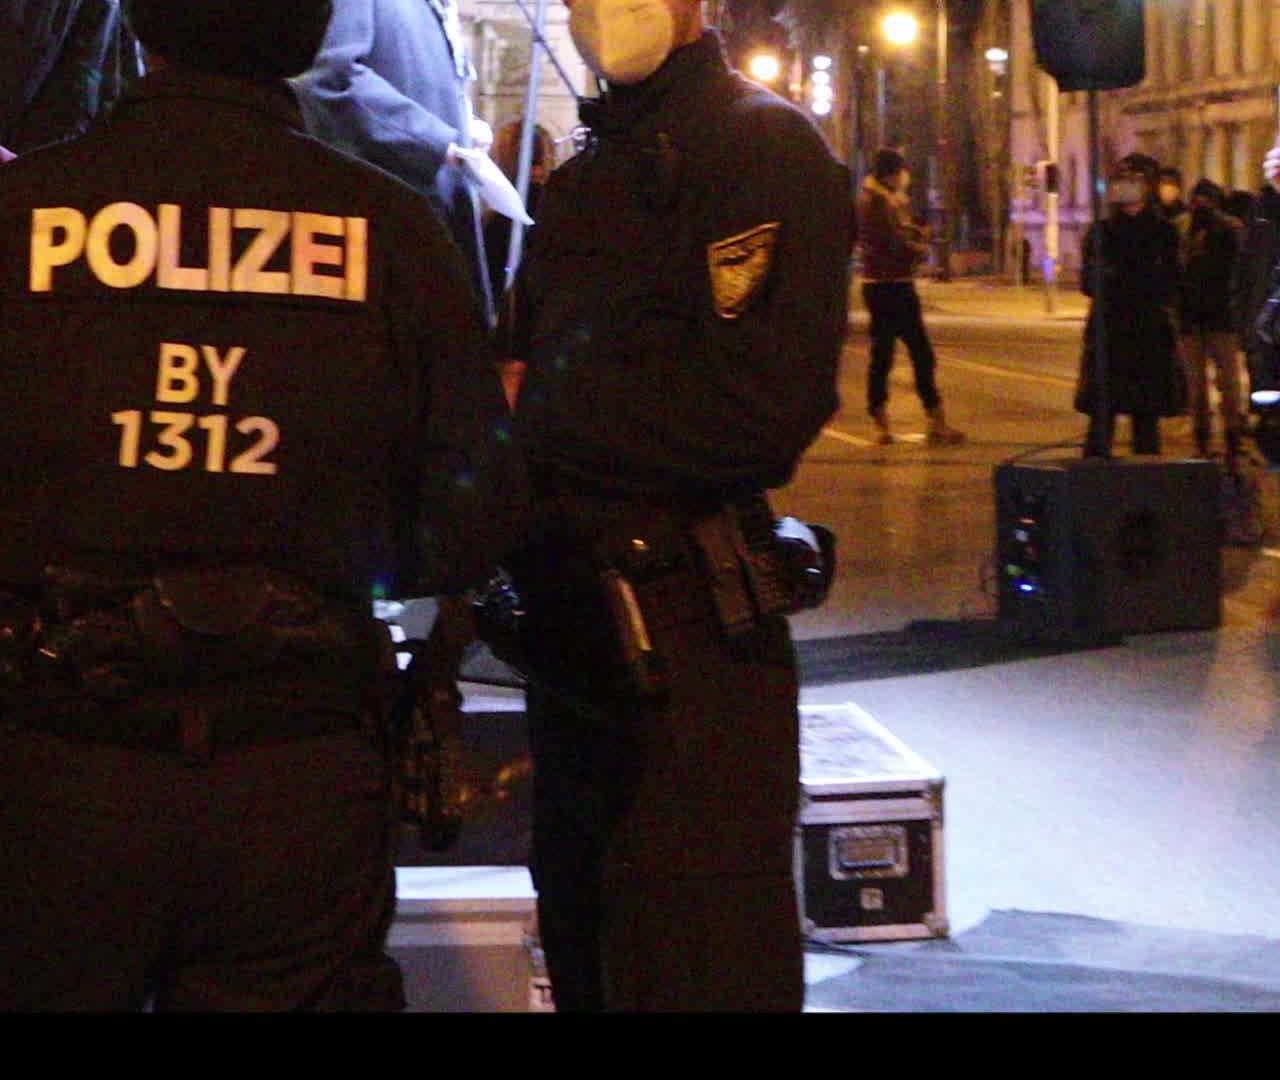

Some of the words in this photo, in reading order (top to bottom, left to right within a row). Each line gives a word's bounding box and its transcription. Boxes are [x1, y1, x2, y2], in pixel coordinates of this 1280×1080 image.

[29, 201, 369, 302] POLIZEI
[155, 341, 248, 406] BY
[111, 409, 281, 475] 1312
